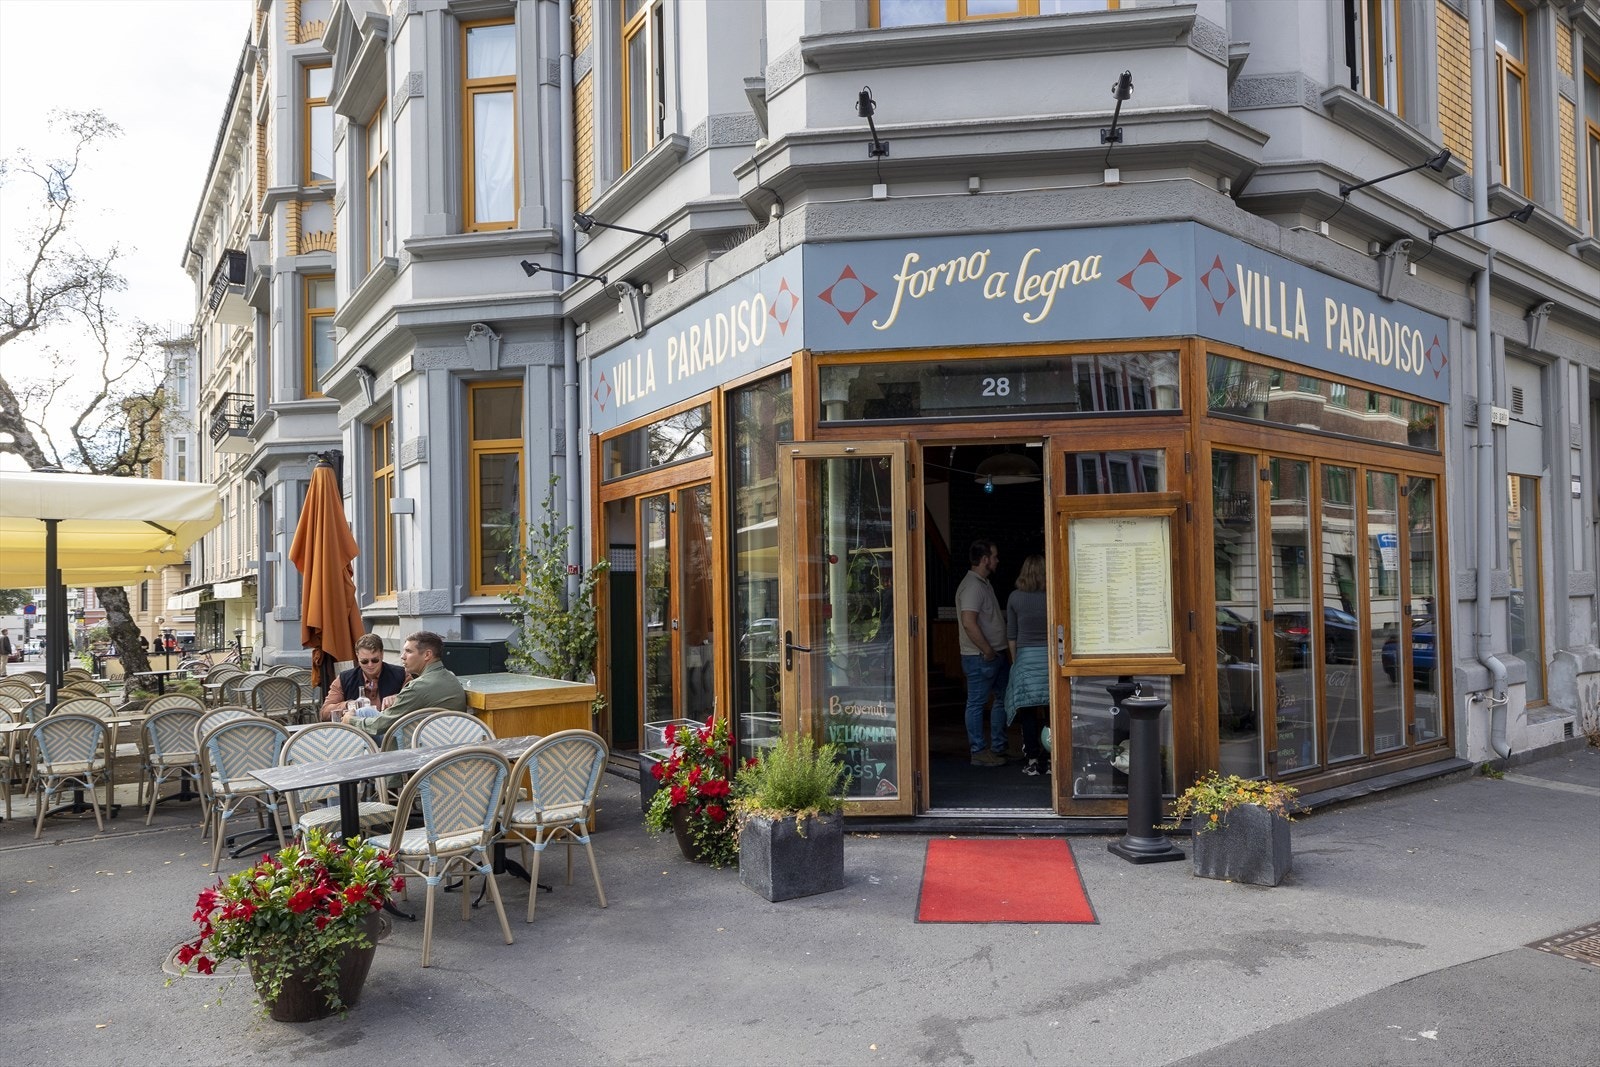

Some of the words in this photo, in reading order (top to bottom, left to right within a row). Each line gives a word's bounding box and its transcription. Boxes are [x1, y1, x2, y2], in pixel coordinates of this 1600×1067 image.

[873, 248, 991, 331] forno
[983, 271, 1009, 299] a
[1013, 247, 1103, 324] legna
[1236, 263, 1310, 343] VILLA
[1324, 297, 1425, 376] PARADISO
[612, 349, 657, 408] VILLA
[667, 292, 768, 382] PARADISO
[982, 377, 1010, 396] 28
[829, 724, 897, 743] VELKOMMEN
[848, 747, 878, 762] TIL
